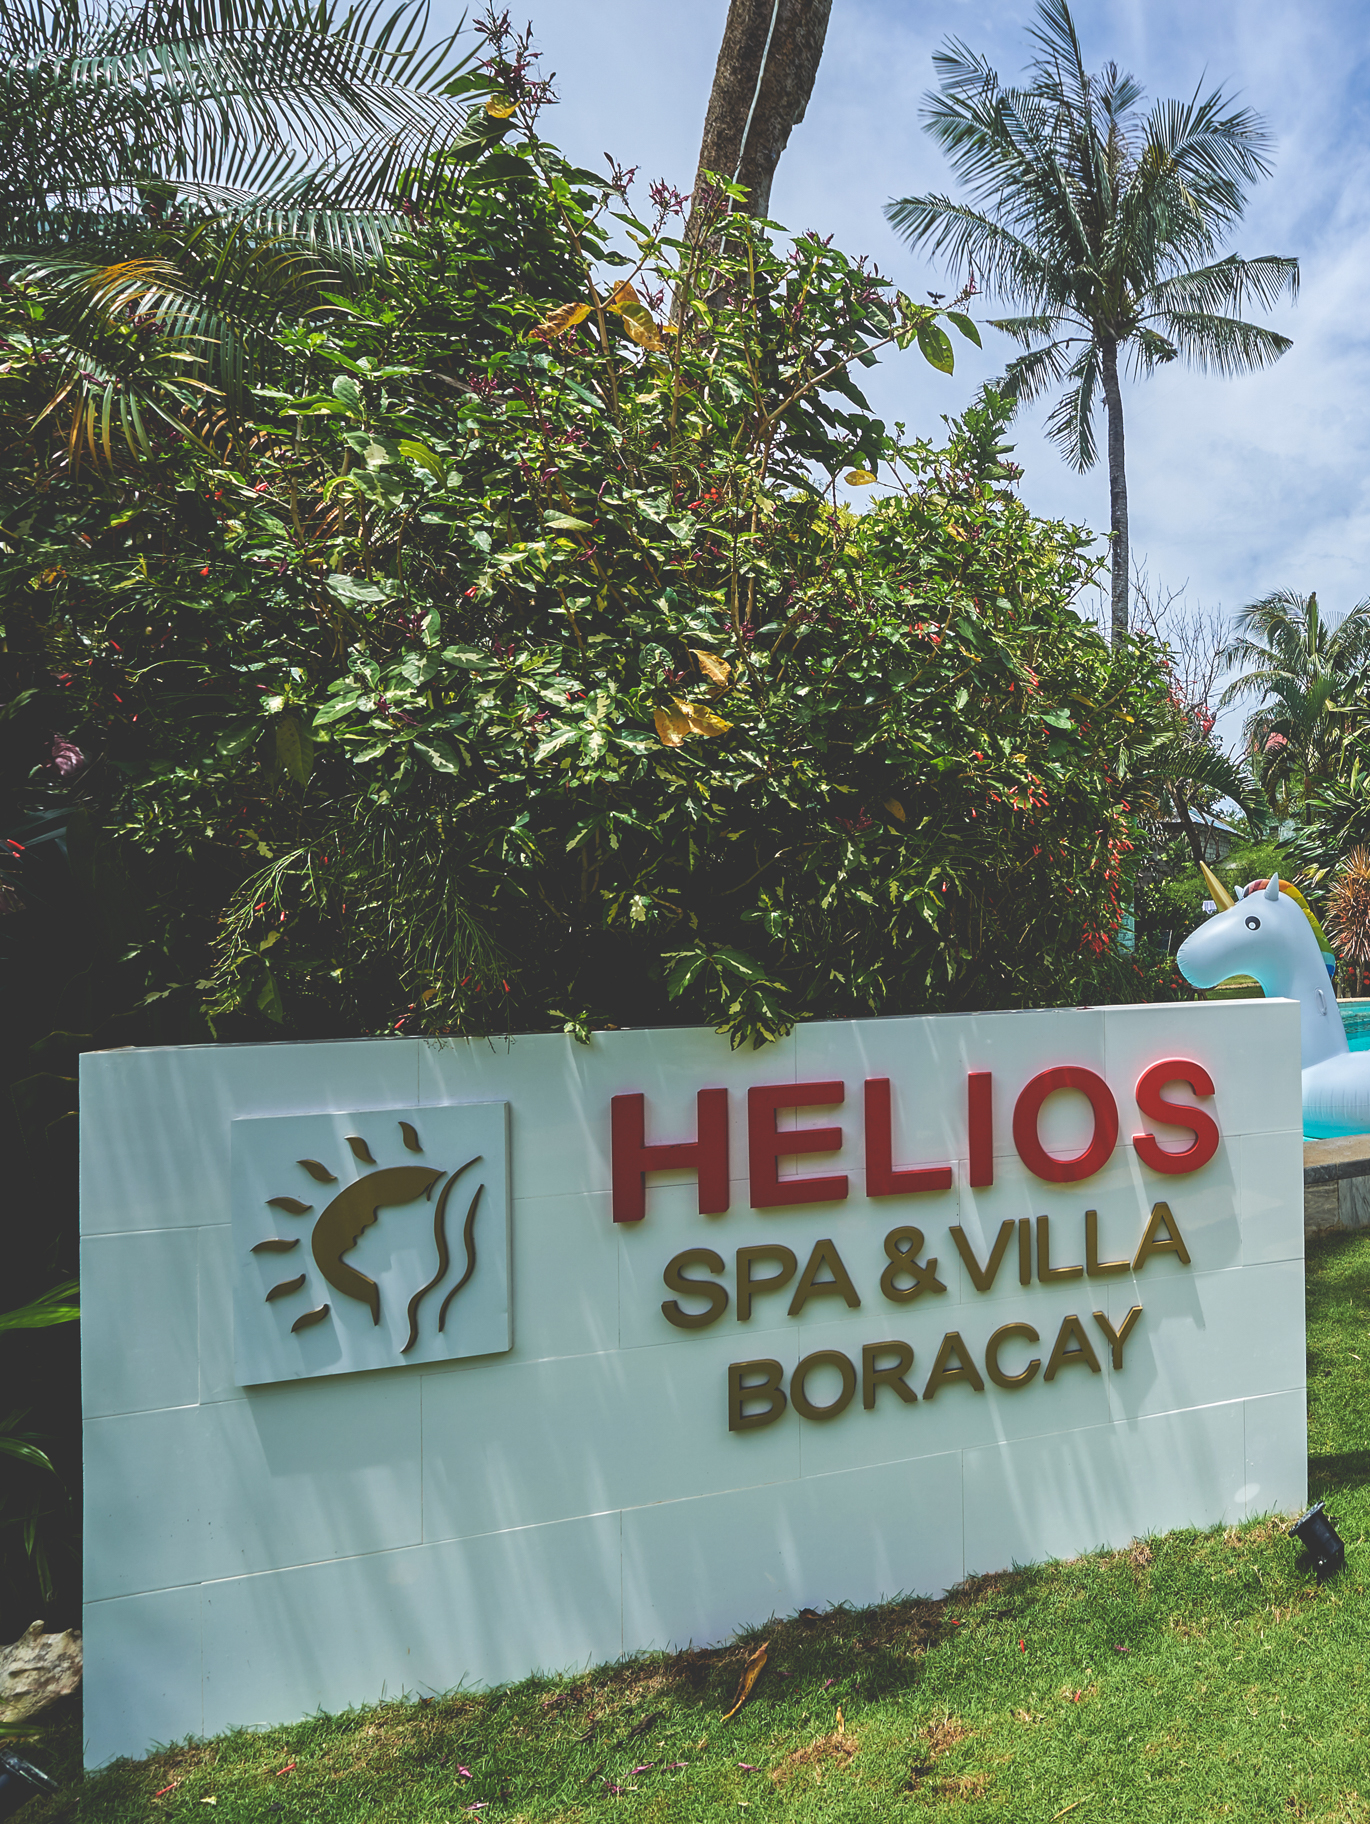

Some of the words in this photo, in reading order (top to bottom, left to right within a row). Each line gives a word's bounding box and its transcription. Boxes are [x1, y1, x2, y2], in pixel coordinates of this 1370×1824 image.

[611, 1058, 1220, 1223] HELIOS
[661, 1239, 861, 1329] SPA
[880, 1226, 947, 1302] &
[949, 1202, 1191, 1292] VILLA
[728, 1306, 1143, 1432] BORACAY
